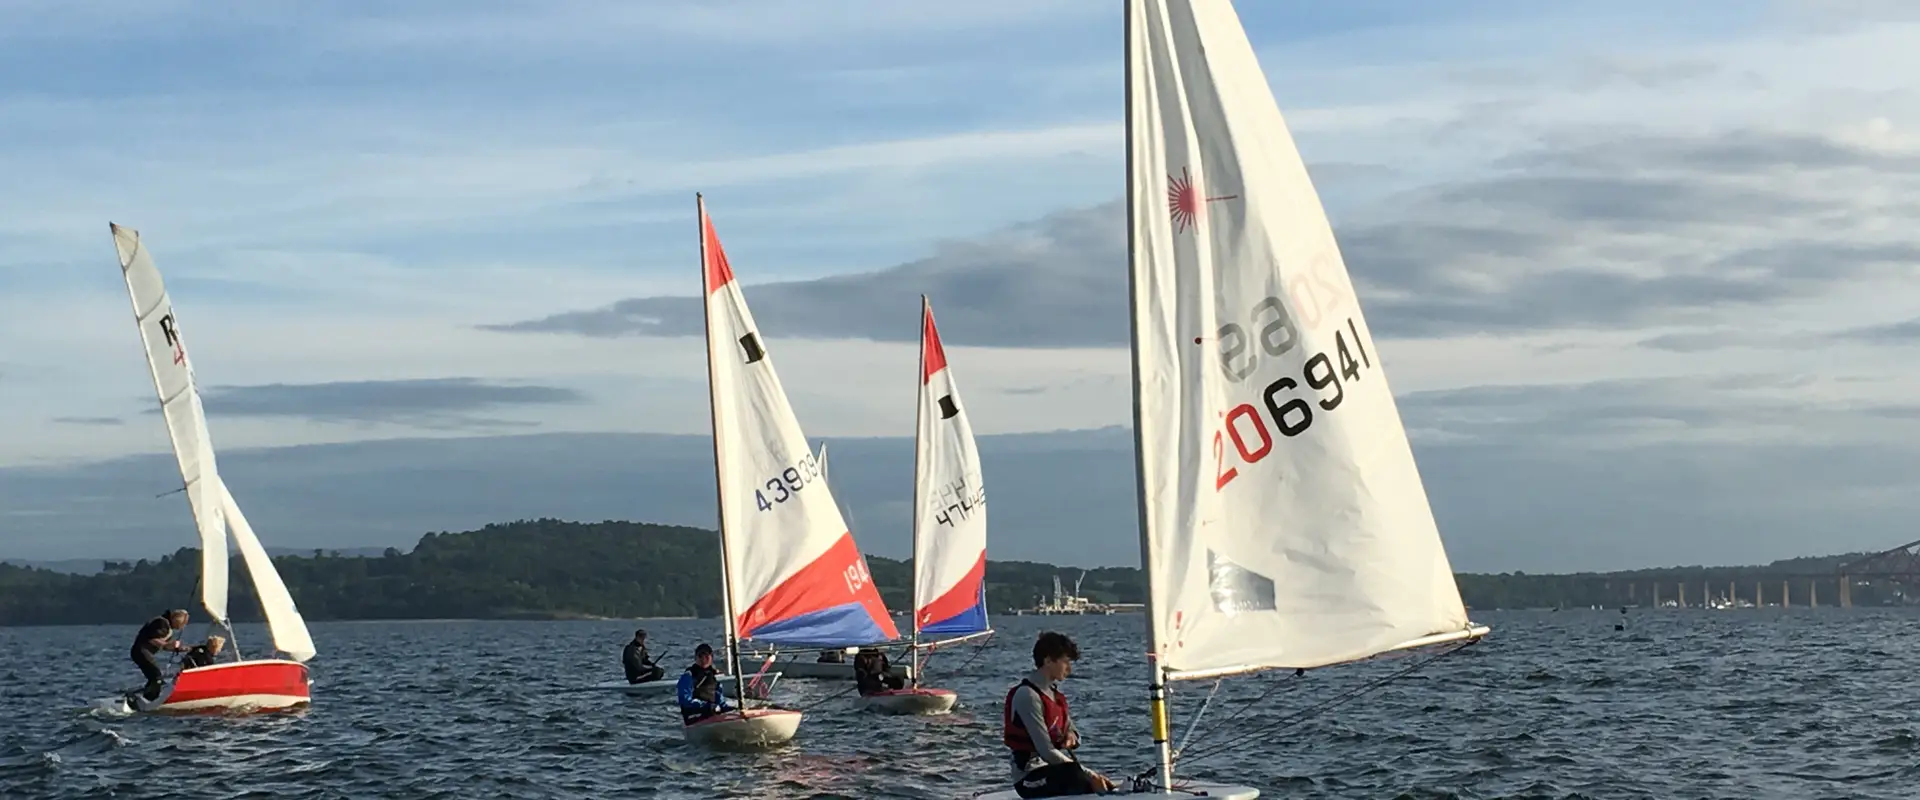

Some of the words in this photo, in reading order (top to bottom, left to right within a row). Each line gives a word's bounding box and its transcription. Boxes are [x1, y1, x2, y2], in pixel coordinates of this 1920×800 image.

[159, 307, 181, 348] R
[1212, 316, 1371, 493] 206941
[755, 453, 818, 512] 43939
